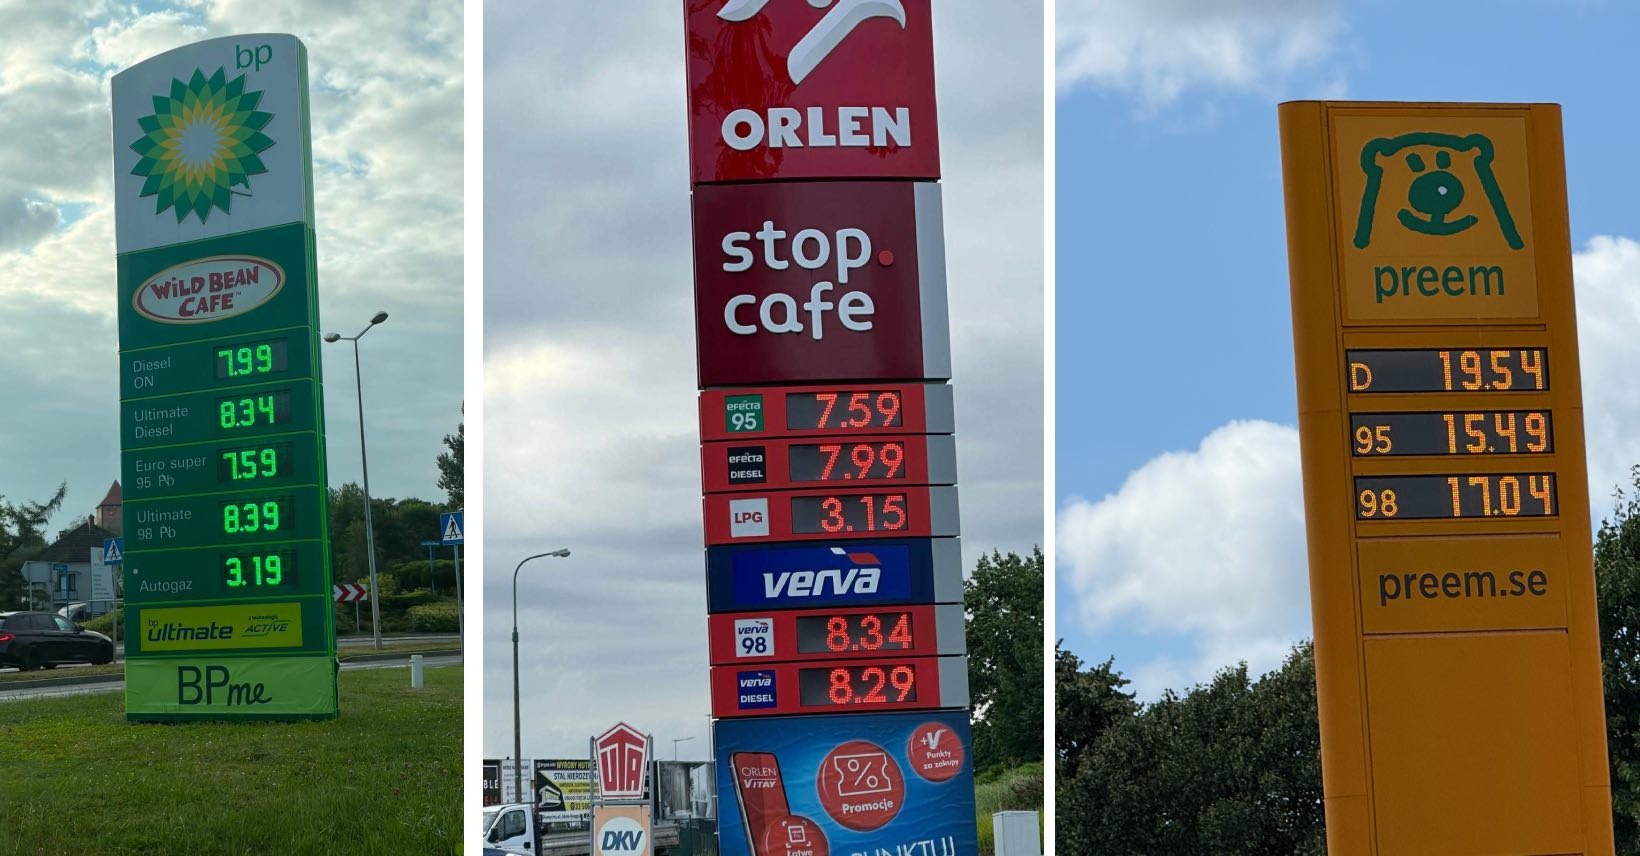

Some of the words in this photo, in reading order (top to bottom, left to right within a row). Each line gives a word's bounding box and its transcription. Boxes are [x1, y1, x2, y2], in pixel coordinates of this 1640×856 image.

[236, 44, 273, 72] bp
[721, 106, 912, 151] ORLEN
[209, 266, 259, 293] BEAN
[1374, 263, 1504, 304] preem
[179, 292, 234, 317] CAFE
[724, 281, 875, 340] cafe
[133, 356, 171, 373] Diesel
[218, 344, 273, 377] 7.99
[1439, 349, 1542, 391] 19.54
[134, 376, 154, 388] ON
[1351, 362, 1372, 391] D
[134, 405, 189, 422] Ultimate
[220, 396, 275, 429] 8.34
[731, 414, 757, 431] 95
[816, 392, 900, 429] 7.59
[135, 423, 173, 438] Diesel
[1355, 425, 1392, 454] 95
[1443, 412, 1547, 454] 15.49
[136, 458, 166, 472] Euro
[170, 455, 208, 470] super
[222, 448, 277, 480] 7.59
[820, 443, 904, 480] 7.99
[136, 476, 151, 488] 95
[159, 474, 175, 488] Pb
[730, 470, 764, 479] DIESEL
[1360, 489, 1398, 518] 98
[1447, 475, 1551, 517] 17.04
[137, 508, 192, 524] Ultimate
[224, 501, 280, 534] 8.39
[734, 511, 763, 524] LPG
[821, 495, 906, 532] 3.15
[138, 528, 152, 540] 98
[160, 525, 176, 539] Pb
[226, 555, 282, 587] 3.19
[763, 568, 881, 598] verva
[140, 578, 193, 593] Autogaz
[1379, 569, 1547, 607] preem.se
[148, 619, 158, 628] bp
[148, 622, 234, 642] ultimate
[245, 623, 288, 633] ACTIVE
[738, 624, 769, 636] verva
[826, 613, 912, 652] 8.34
[742, 637, 767, 654] 98
[740, 676, 772, 688] verva
[828, 666, 915, 705] 8.29
[740, 694, 774, 704] DIESEL
[599, 729, 644, 792] UTA
[926, 750, 952, 758] Punkty
[934, 760, 959, 769] zakupy
[741, 767, 777, 777] ORLEN
[842, 798, 894, 814] Promocje
[602, 830, 643, 851] DKV
